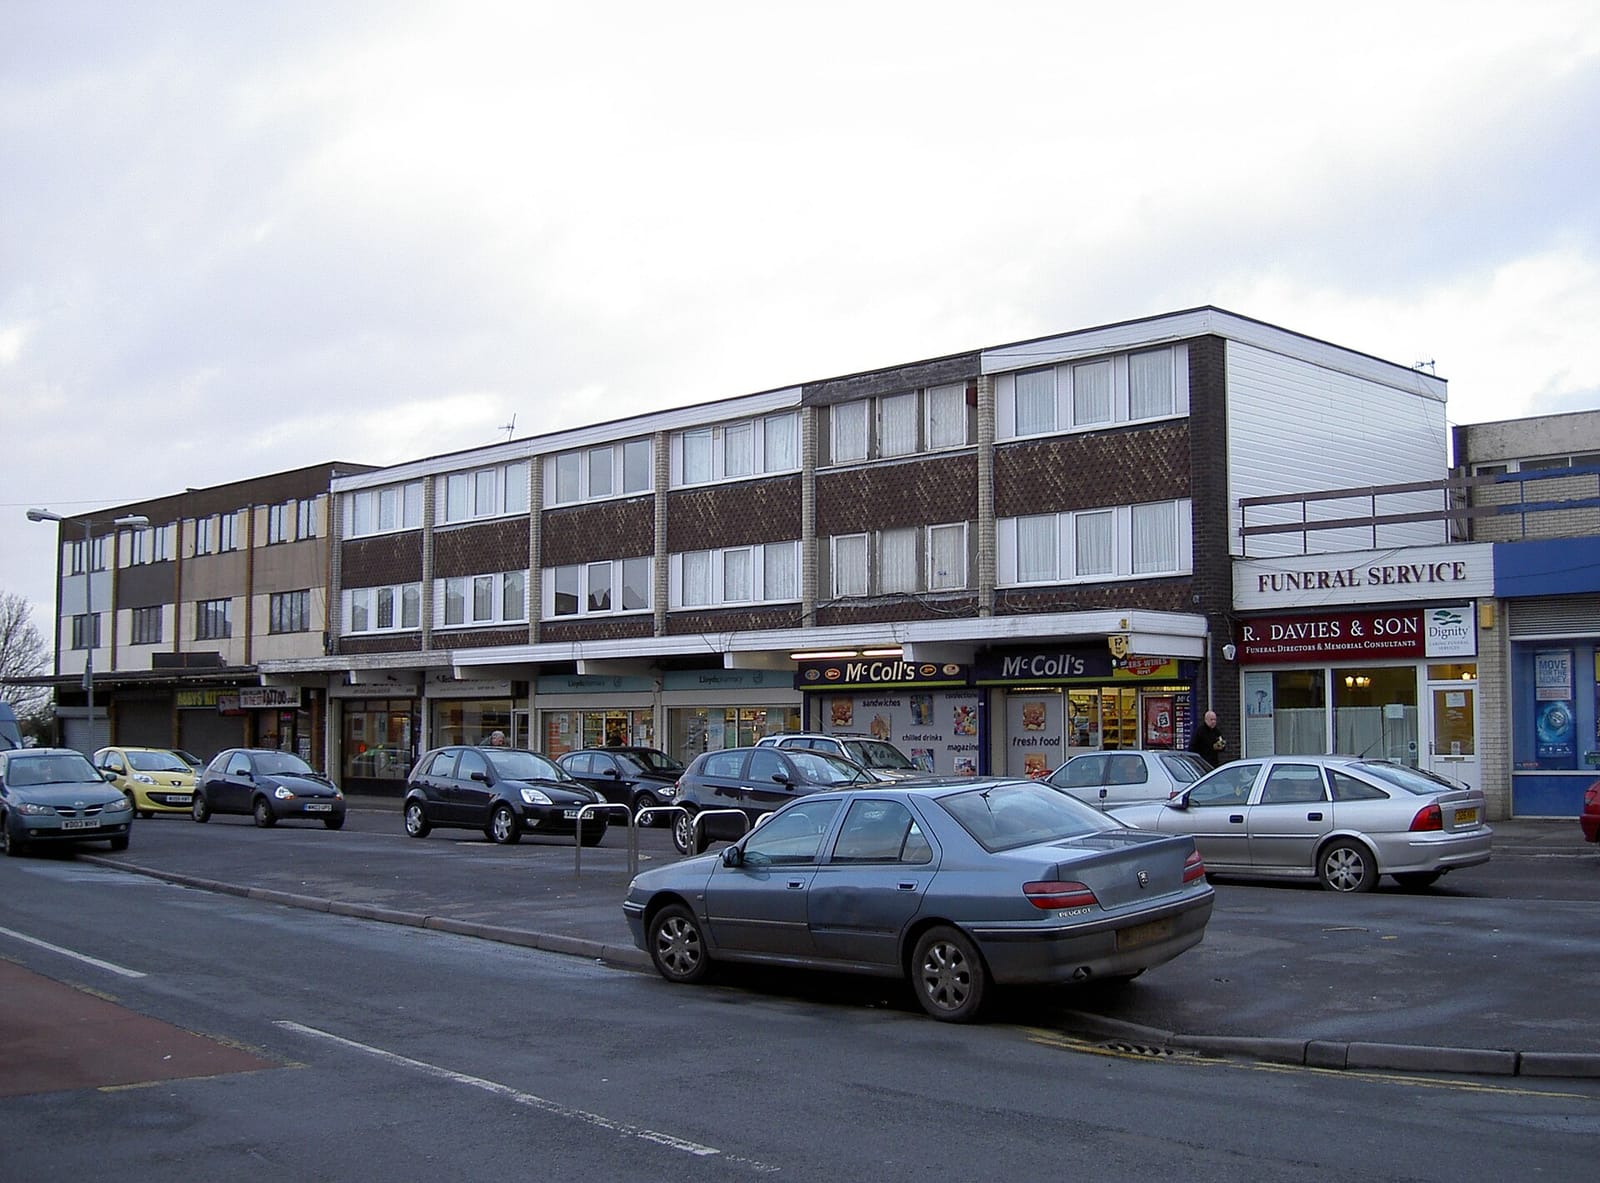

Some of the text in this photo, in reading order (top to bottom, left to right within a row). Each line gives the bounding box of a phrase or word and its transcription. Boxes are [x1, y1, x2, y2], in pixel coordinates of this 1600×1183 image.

[1258, 561, 1466, 592] FUNERAL SERVICE
[1242, 617, 1418, 642] R. DAVIES & SON
[1429, 626, 1468, 640] Dignity
[1246, 645, 1276, 654] FUNERAL
[1277, 643, 1316, 653] DIRECTORS
[1364, 640, 1416, 649] CONSULTANTS
[1002, 654, 1085, 677] McColl's
[1539, 659, 1567, 669] MOVE
[845, 661, 915, 682] McColl's
[902, 733, 942, 742] chilled drinks
[1012, 735, 1061, 747] fresh food
[1058, 908, 1091, 918] PEUGEOT
